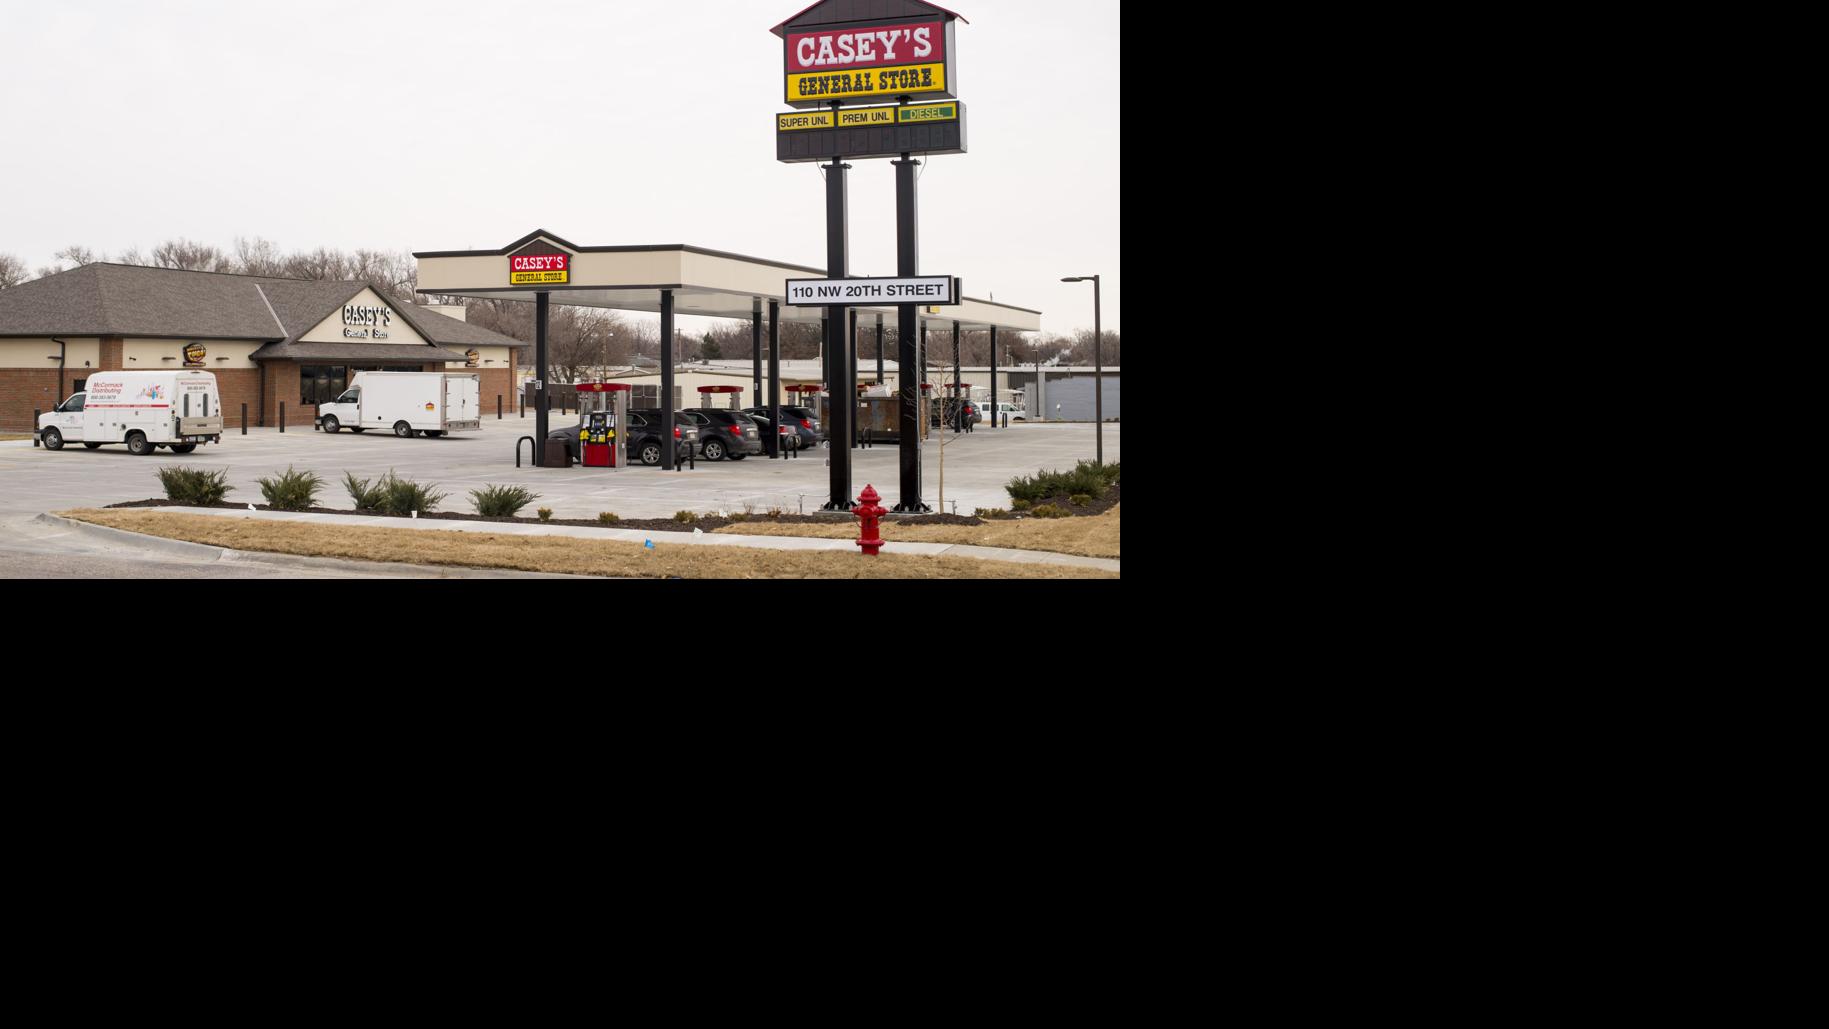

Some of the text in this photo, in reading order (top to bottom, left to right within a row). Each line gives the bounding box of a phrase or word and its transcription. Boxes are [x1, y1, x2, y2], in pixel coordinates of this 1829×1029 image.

[797, 27, 932, 67] CASEY'S
[798, 67, 932, 96] GENERAL STORE
[842, 111, 890, 123] PREM UNL
[910, 107, 944, 119] DIESEL
[780, 115, 829, 128] SUPER UNL
[514, 256, 564, 270] CASEY'S
[515, 273, 542, 282] GENERAL
[792, 284, 944, 298] 110 NW 20TH STREET
[342, 305, 391, 326] CASEY'S
